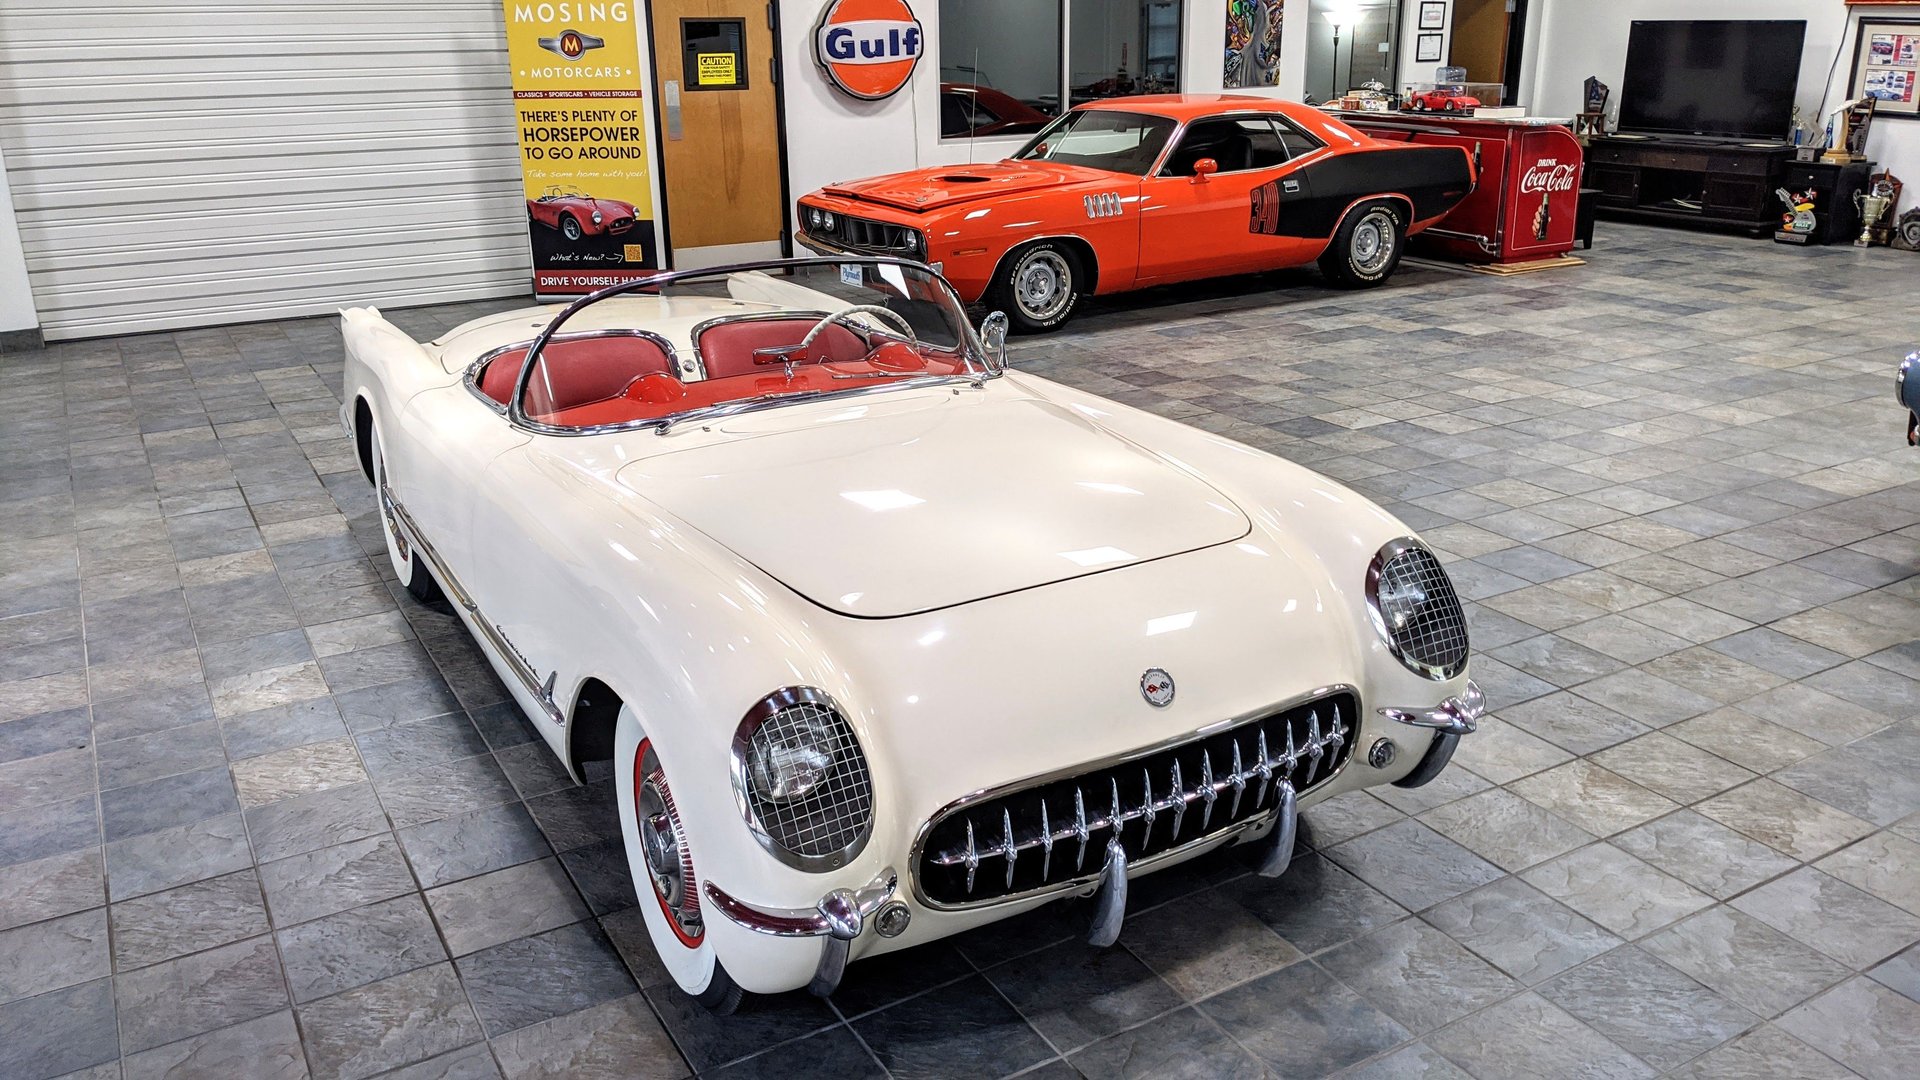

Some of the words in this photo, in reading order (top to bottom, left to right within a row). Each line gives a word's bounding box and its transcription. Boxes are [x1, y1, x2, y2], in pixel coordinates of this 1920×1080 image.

[514, 3, 628, 22] MOSING
[564, 37, 579, 52] M
[826, 27, 919, 59] Gulf
[701, 57, 732, 65] CAUTION
[531, 66, 621, 78] MOTORCARS
[517, 90, 543, 98] CLASSICS
[520, 110, 569, 122] THERE'S
[572, 110, 616, 122] PLENTY
[620, 110, 638, 121] OF
[523, 127, 640, 142] HORSEPOWER
[524, 147, 544, 159] TO
[548, 147, 574, 159] GO
[578, 147, 641, 159] AROUND
[1537, 158, 1557, 167] DRINK
[527, 169, 547, 178] Take
[576, 169, 600, 178] home
[602, 169, 624, 178] with
[625, 169, 647, 180] you!
[1521, 164, 1577, 193] Coca-Cola
[1251, 182, 1279, 233] 340
[549, 252, 580, 261] What's
[582, 253, 605, 261] New?
[541, 276, 569, 286] DRIVE
[572, 276, 619, 286] YOURSELF
